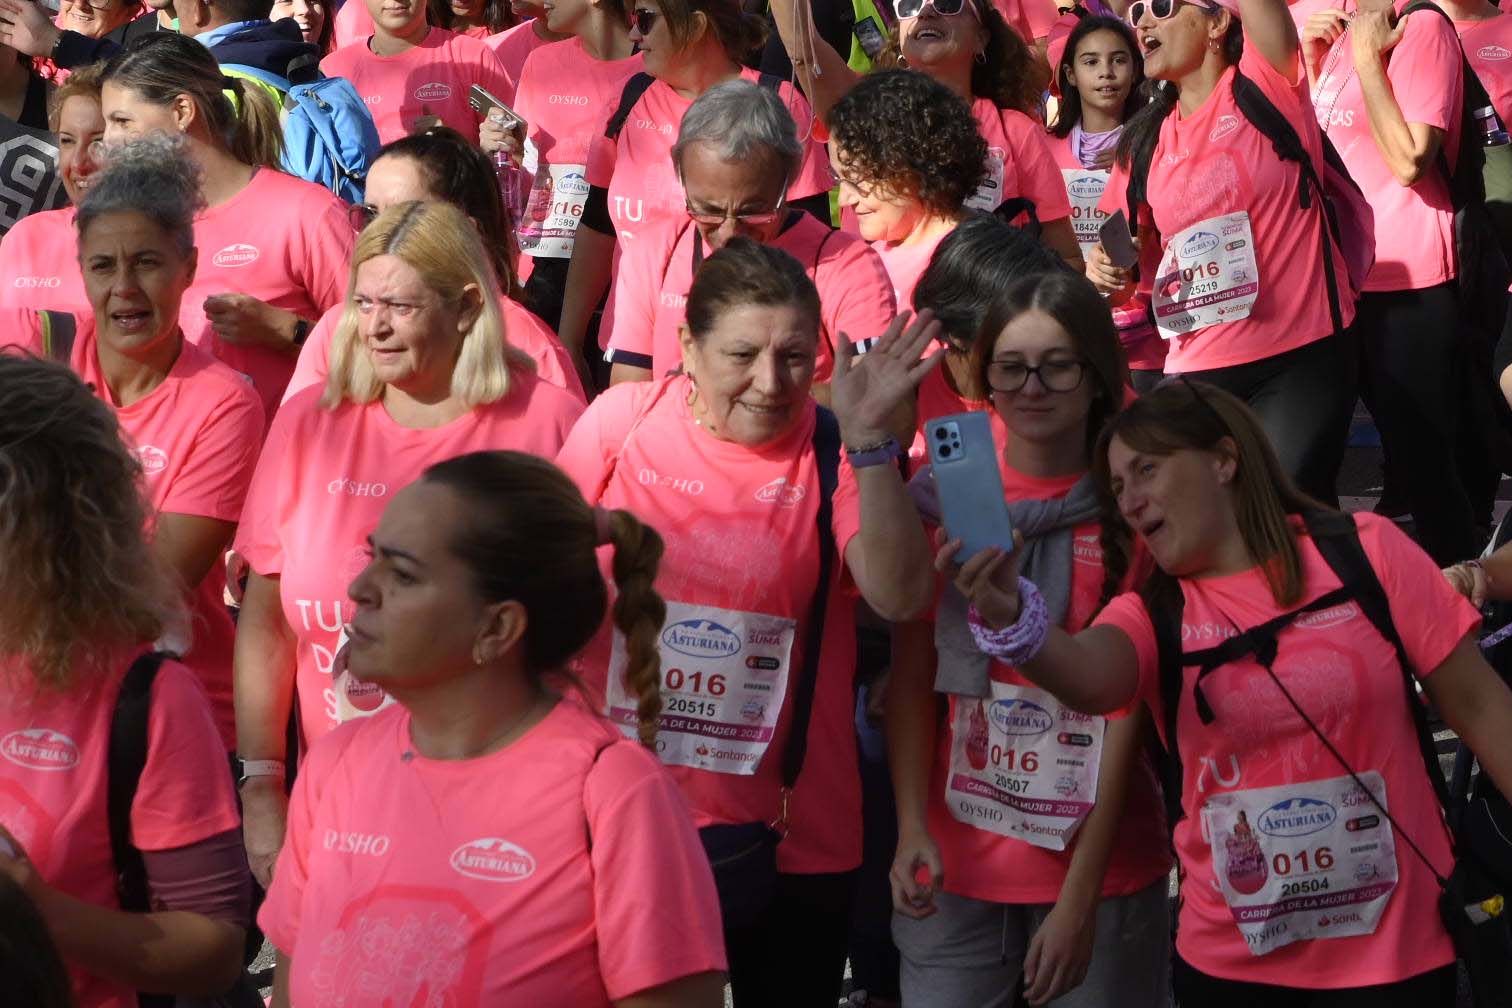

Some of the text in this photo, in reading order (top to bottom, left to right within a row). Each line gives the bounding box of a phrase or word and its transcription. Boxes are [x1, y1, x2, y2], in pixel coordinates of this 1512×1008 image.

[548, 94, 589, 106] OYSHO
[1070, 185, 1105, 193] ASTURIAN
[614, 196, 643, 222] TU
[1072, 206, 1104, 219] 016
[1074, 223, 1099, 231] 18424
[1182, 261, 1220, 282] 016
[1189, 281, 1218, 296] 25219
[1168, 314, 1201, 329] OYSHO
[296, 599, 343, 633] TU
[667, 629, 735, 653] ASTURIANA
[665, 668, 727, 697] 016
[668, 697, 716, 717] 20515
[670, 718, 685, 728] DE
[687, 721, 701, 731] LA
[702, 723, 738, 738] MUJER
[990, 744, 1040, 772] 016
[994, 773, 1030, 794] 20507
[959, 800, 1003, 823] OYSHO
[1020, 800, 1053, 813] MUJER
[1263, 810, 1332, 831] ASTURIANA
[458, 850, 528, 875] ASTURIANA
[1272, 847, 1335, 876] 016
[1281, 877, 1329, 897] 20504
[1287, 899, 1302, 910] DE
[1303, 897, 1317, 908] LA
